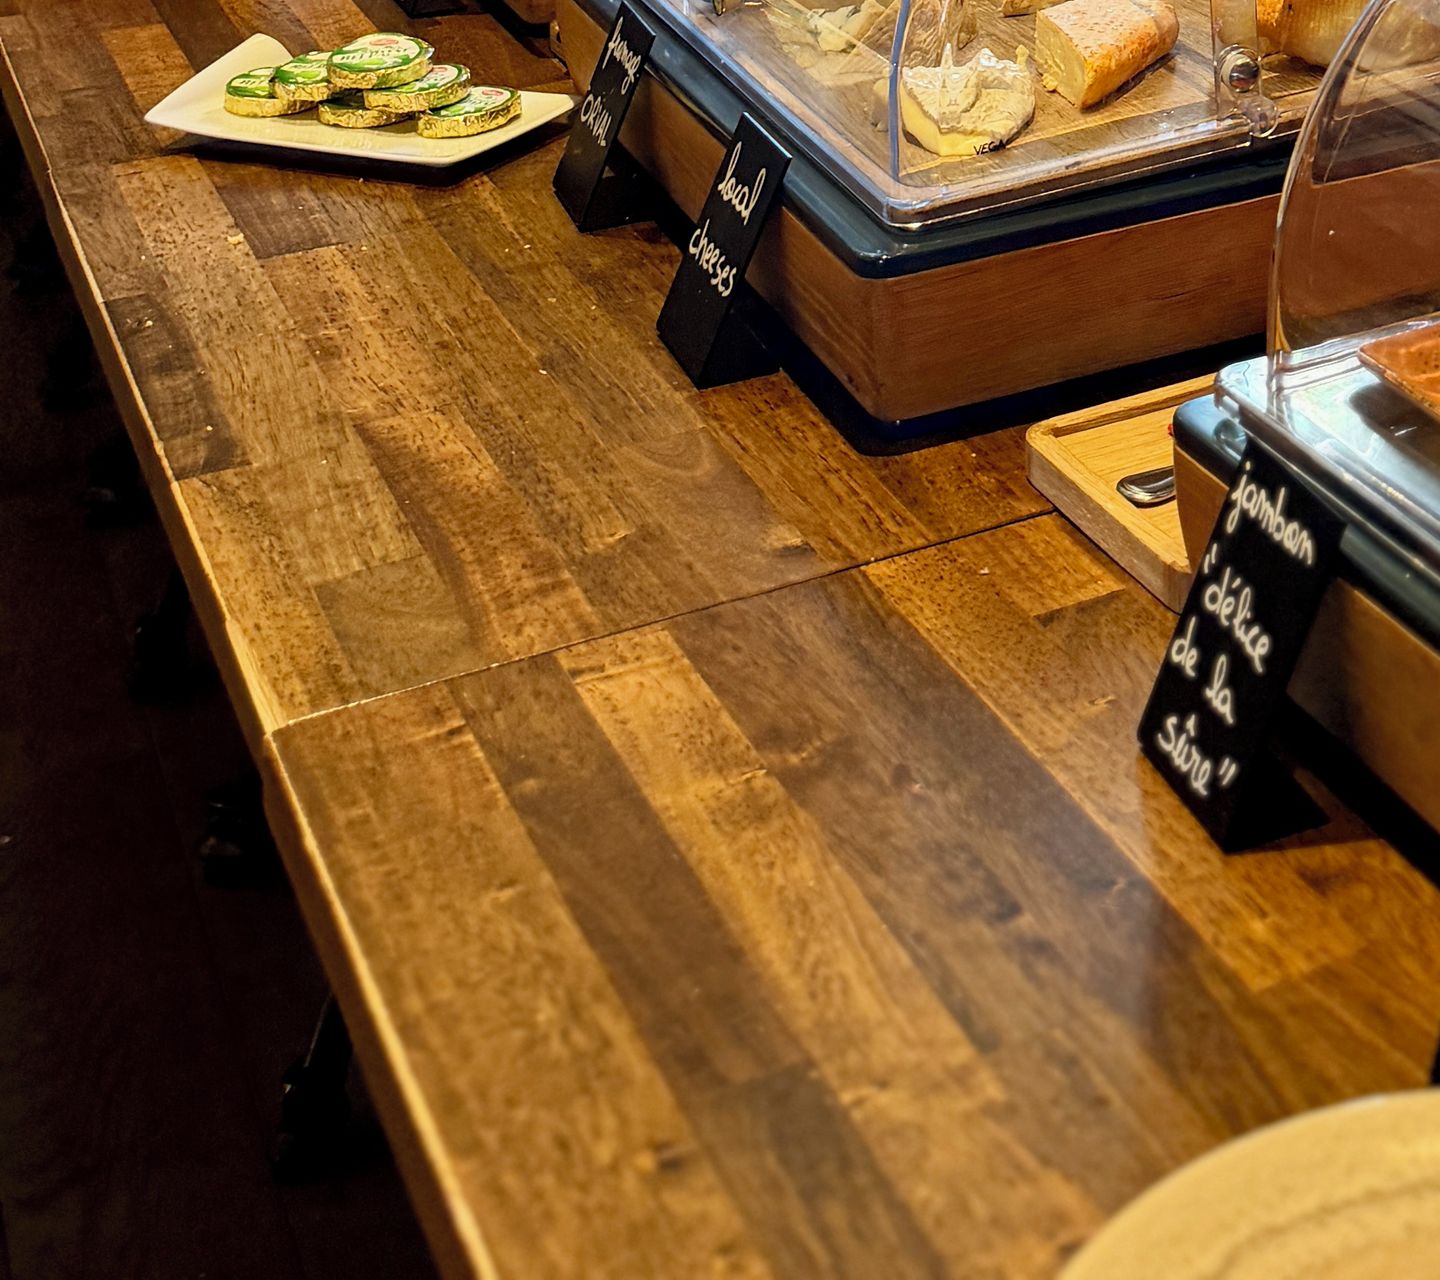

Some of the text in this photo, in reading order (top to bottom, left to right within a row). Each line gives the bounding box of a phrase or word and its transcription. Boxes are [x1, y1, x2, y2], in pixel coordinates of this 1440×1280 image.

[581, 93, 611, 147] ORVAL
[718, 142, 767, 226] local
[689, 219, 738, 298] cheeses
[1226, 461, 1314, 565] jambon
[1171, 617, 1235, 726] de la
